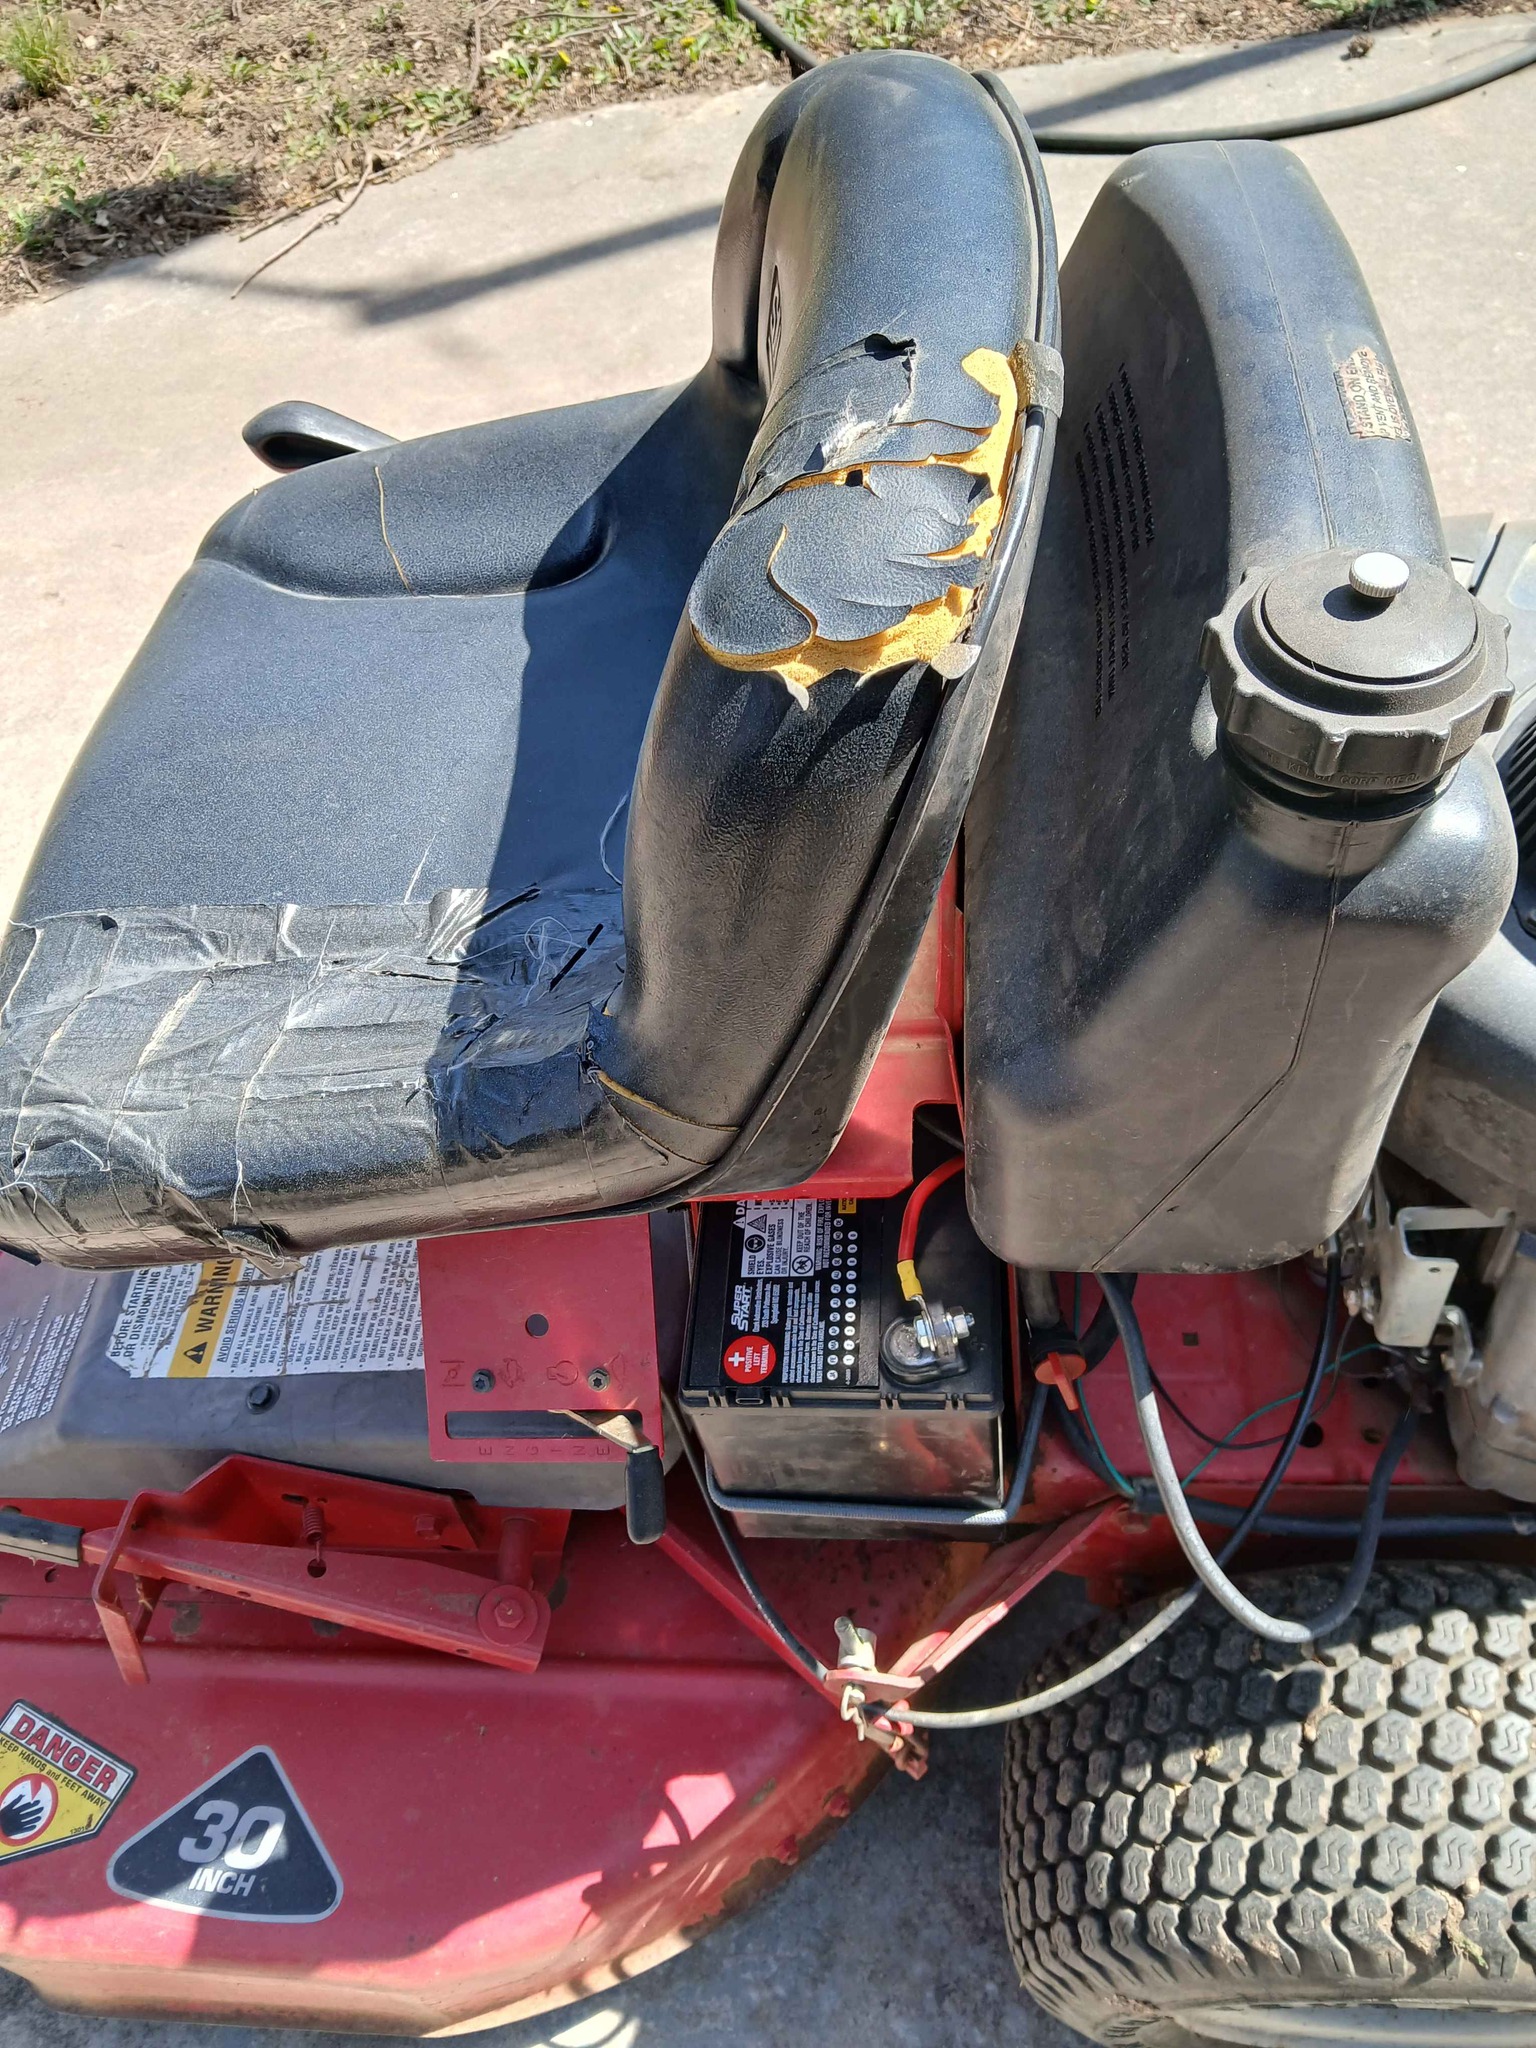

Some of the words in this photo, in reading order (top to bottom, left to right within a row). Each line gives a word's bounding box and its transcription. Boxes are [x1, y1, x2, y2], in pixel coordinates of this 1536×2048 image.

[767, 1224, 776, 1242] GASES
[776, 1218, 784, 1245] BLINDNESS
[341, 1252, 348, 1260] OR
[401, 1249, 410, 1264] MOW
[747, 1254, 756, 1275] SHIELD
[765, 1243, 774, 1274] EXPLOSIVE
[774, 1247, 782, 1263] CAUSE
[305, 1277, 316, 1296] CAUSE
[311, 1255, 321, 1275] INJURY
[337, 1261, 347, 1275] OFF)
[398, 1265, 406, 1278] NOT
[332, 1277, 342, 1295] BLADE
[380, 1275, 387, 1284] OR
[395, 1278, 404, 1288] DO
[129, 1271, 161, 1340] DISMOUNTING
[170, 1288, 181, 1305] MUST
[249, 1294, 258, 1306] AND
[331, 1315, 339, 1330] KEEP
[342, 1268, 353, 1288] SAFELY
[380, 1287, 392, 1316] TRACTION
[731, 1285, 742, 1325] SUPER
[110, 1319, 133, 1357] BEFORE
[125, 1269, 150, 1316] STARTING
[140, 1326, 152, 1345] PRESS
[148, 1282, 167, 1324] CLUTCH/BRAKE
[370, 1312, 378, 1321] ON
[398, 1295, 409, 1319] ACROSS
[406, 1304, 416, 1322] AVOID
[738, 1285, 752, 1331] START
[148, 1322, 162, 1345] ENGAGE
[157, 1295, 171, 1320] PARKING
[240, 1308, 254, 1337] MANUALS
[259, 1343, 270, 1364] OTHER
[265, 1319, 277, 1341] SAFETY
[273, 1293, 285, 1317] DEVICES
[311, 1319, 322, 1340] ALLOW
[322, 1314, 332, 1332] (EVEN
[340, 1347, 350, 1363] LOOK
[345, 1326, 355, 1345] DOWN
[351, 1312, 359, 1325] AND
[355, 1288, 365, 1311] BEHIND
[377, 1317, 385, 1327] OR
[393, 1321, 402, 1337] MOW
[402, 1323, 411, 1336] AND
[217, 1336, 233, 1362] AVOID
[225, 1298, 244, 1334] SERIOUS
[366, 1322, 375, 1338] MOW
[381, 1317, 393, 1344] BACK-UP
[122, 1342, 137, 1357] OR
[236, 1339, 245, 1350] ALL
[240, 1347, 251, 1364] WITH
[246, 1335, 255, 1346] THE
[249, 1351, 260, 1367] MAKE
[255, 1333, 265, 1348] SURE
[260, 1316, 270, 1331] THAT
[307, 1342, 315, 1354] NOT
[314, 1334, 326, 1361] MACHINE
[331, 1326, 346, 1360] OPERATING
[350, 1340, 360, 1359] WHILE
[362, 1340, 370, 1352] NOT
[369, 1328, 382, 1358] STABILITY
[390, 1339, 398, 1351] NOT
[397, 1337, 407, 1357] SPEED
[406, 1342, 416, 1360] AVOID
[230, 1351, 241, 1368] READ
[268, 1350, 277, 1363] AND
[304, 1356, 312, 1365] DO
[359, 1353, 367, 1362] DO
[378, 1346, 386, 1358] NOT
[387, 1352, 395, 1361] DO
[744, 1346, 753, 1372] POSITIVE
[760, 1345, 769, 1374] TERMINAL
[10, 1713, 118, 1793] DANGER
[18, 1750, 47, 1773] HANDS
[46, 1769, 61, 1782] and
[60, 1776, 83, 1794] FEET
[80, 1789, 107, 1809] AWAY
[177, 1799, 287, 1872] 30
[187, 1867, 257, 1898] INCH
